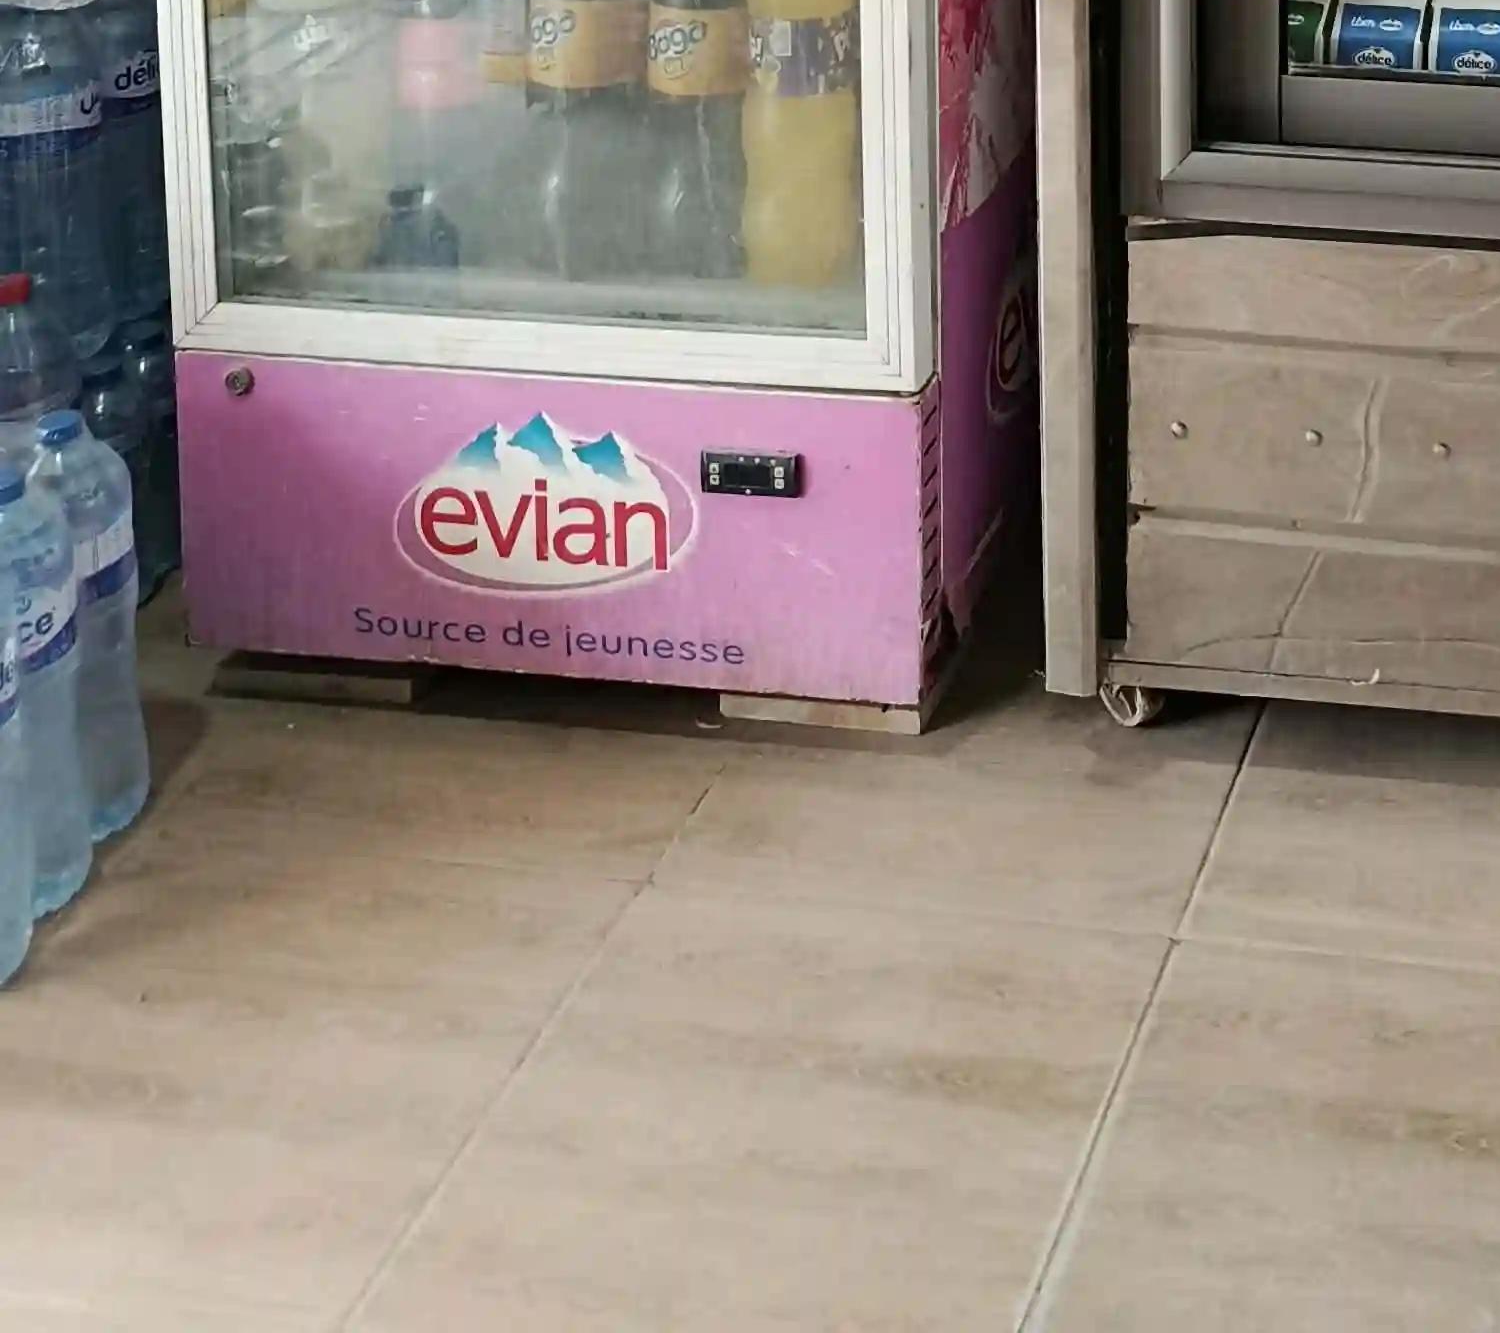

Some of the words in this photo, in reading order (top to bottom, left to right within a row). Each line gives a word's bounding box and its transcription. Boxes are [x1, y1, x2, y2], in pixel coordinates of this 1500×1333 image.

[419, 478, 671, 572] evian
[354, 606, 486, 646] Source
[503, 619, 551, 649] de
[562, 626, 746, 667] jeunesse
